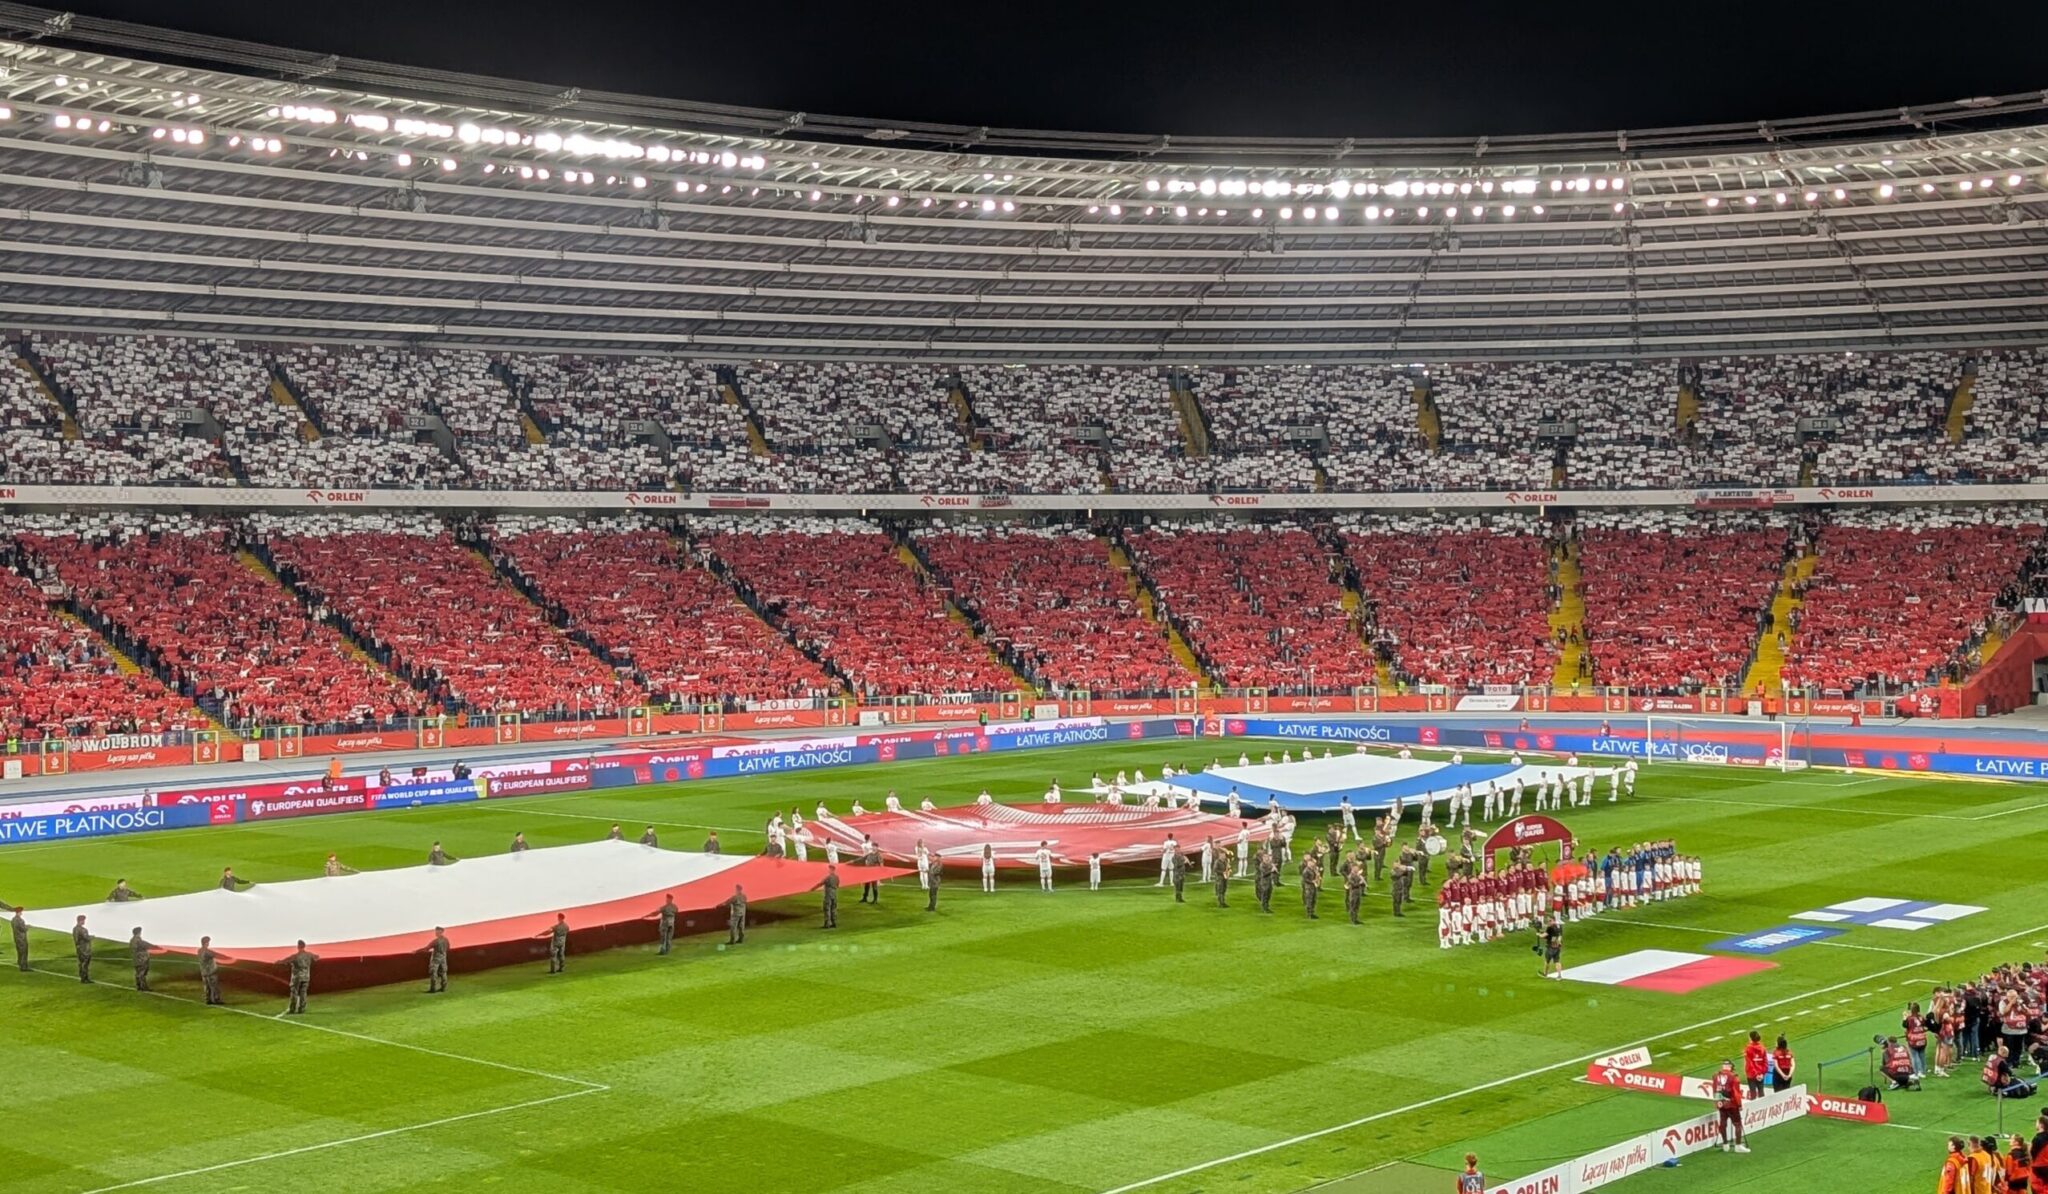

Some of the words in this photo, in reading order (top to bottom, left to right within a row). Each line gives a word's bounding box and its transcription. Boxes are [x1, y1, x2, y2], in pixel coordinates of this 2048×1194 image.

[327, 493, 363, 502] ORLEN
[643, 495, 676, 504] ORLEN
[938, 498, 969, 506] ORLEN
[1227, 497, 1259, 505] ORLEN
[1524, 494, 1557, 502] ORLEN
[1838, 490, 1873, 498] ORLEN
[1016, 731, 1051, 746] ŁATWE
[1053, 726, 1107, 744] PŁATNOŚCI
[1278, 724, 1318, 737] ŁATWE
[1321, 725, 1390, 741] PŁATNOŚCI
[82, 735, 162, 752] WOLBROM
[1593, 739, 1640, 754] ŁATWE
[1645, 741, 1728, 757] PŁATNOŚCI
[738, 756, 780, 772] ŁATWE
[784, 749, 852, 767] PŁATNOŚCI
[1976, 758, 2034, 774] ŁATWE
[503, 780, 544, 790] EUROPEAN
[545, 775, 587, 786] QUALIFIERS
[266, 799, 314, 812] EUROPEAN
[316, 795, 364, 806] QUALIFIERS
[371, 793, 387, 801] FIFA
[388, 791, 414, 800] WORLD
[55, 808, 164, 835] PŁATNOŚCI
[1618, 1052, 1641, 1067] ORLEN
[1624, 1073, 1665, 1090] ORLEN
[1744, 1106, 1768, 1127] Łączy
[1768, 1102, 1782, 1119] nas
[1781, 1093, 1801, 1120] piłka
[1821, 1099, 1866, 1116] ORLEN
[1582, 1162, 1608, 1186] Łączy
[1609, 1156, 1625, 1174] nas
[1624, 1144, 1647, 1176] piłka
